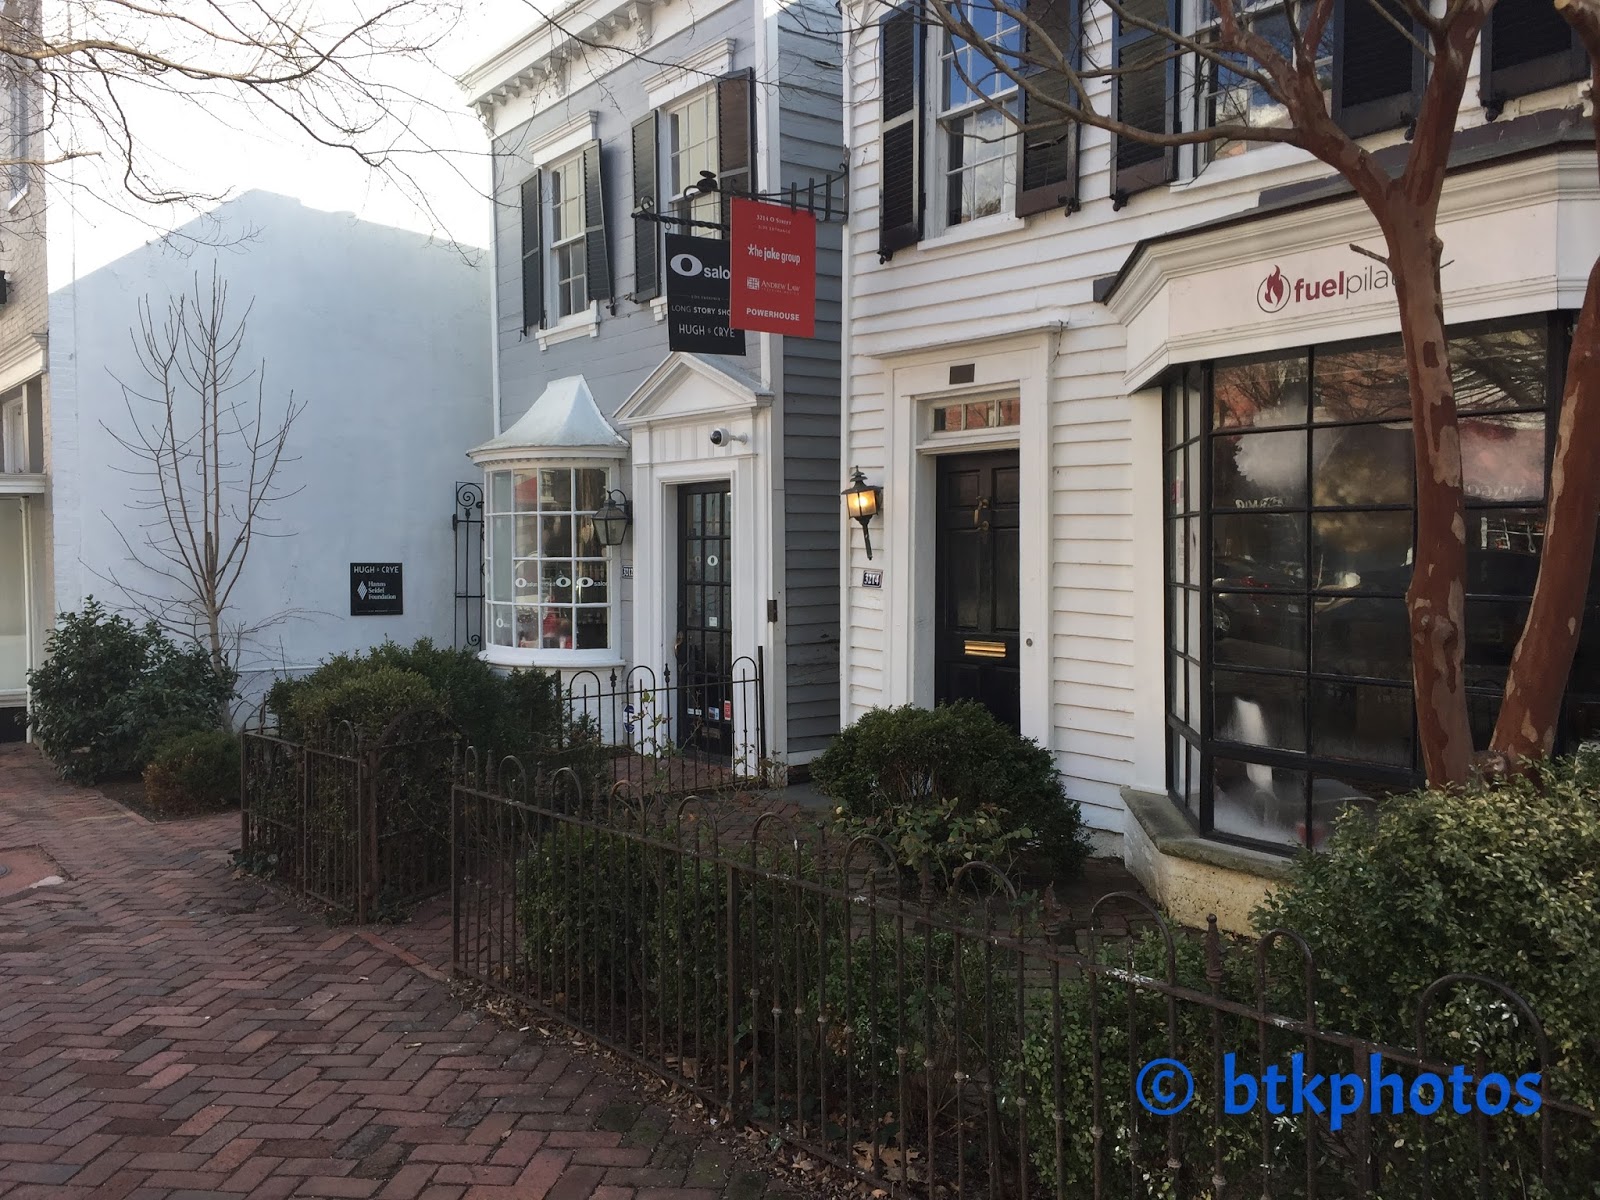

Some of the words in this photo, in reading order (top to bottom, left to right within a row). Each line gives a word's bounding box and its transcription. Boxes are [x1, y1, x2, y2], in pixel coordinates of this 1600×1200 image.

[763, 247, 780, 261] jake
[780, 252, 801, 266] group
[703, 265, 731, 279] salo
[671, 304, 691, 313] LONG
[693, 306, 715, 315] STORY
[717, 308, 731, 316] SHO
[746, 307, 800, 321] POWERHOUSE
[678, 323, 705, 336] HUGH
[713, 326, 736, 338] CRYE
[353, 565, 375, 573] HUGH
[381, 565, 399, 573] CRYE
